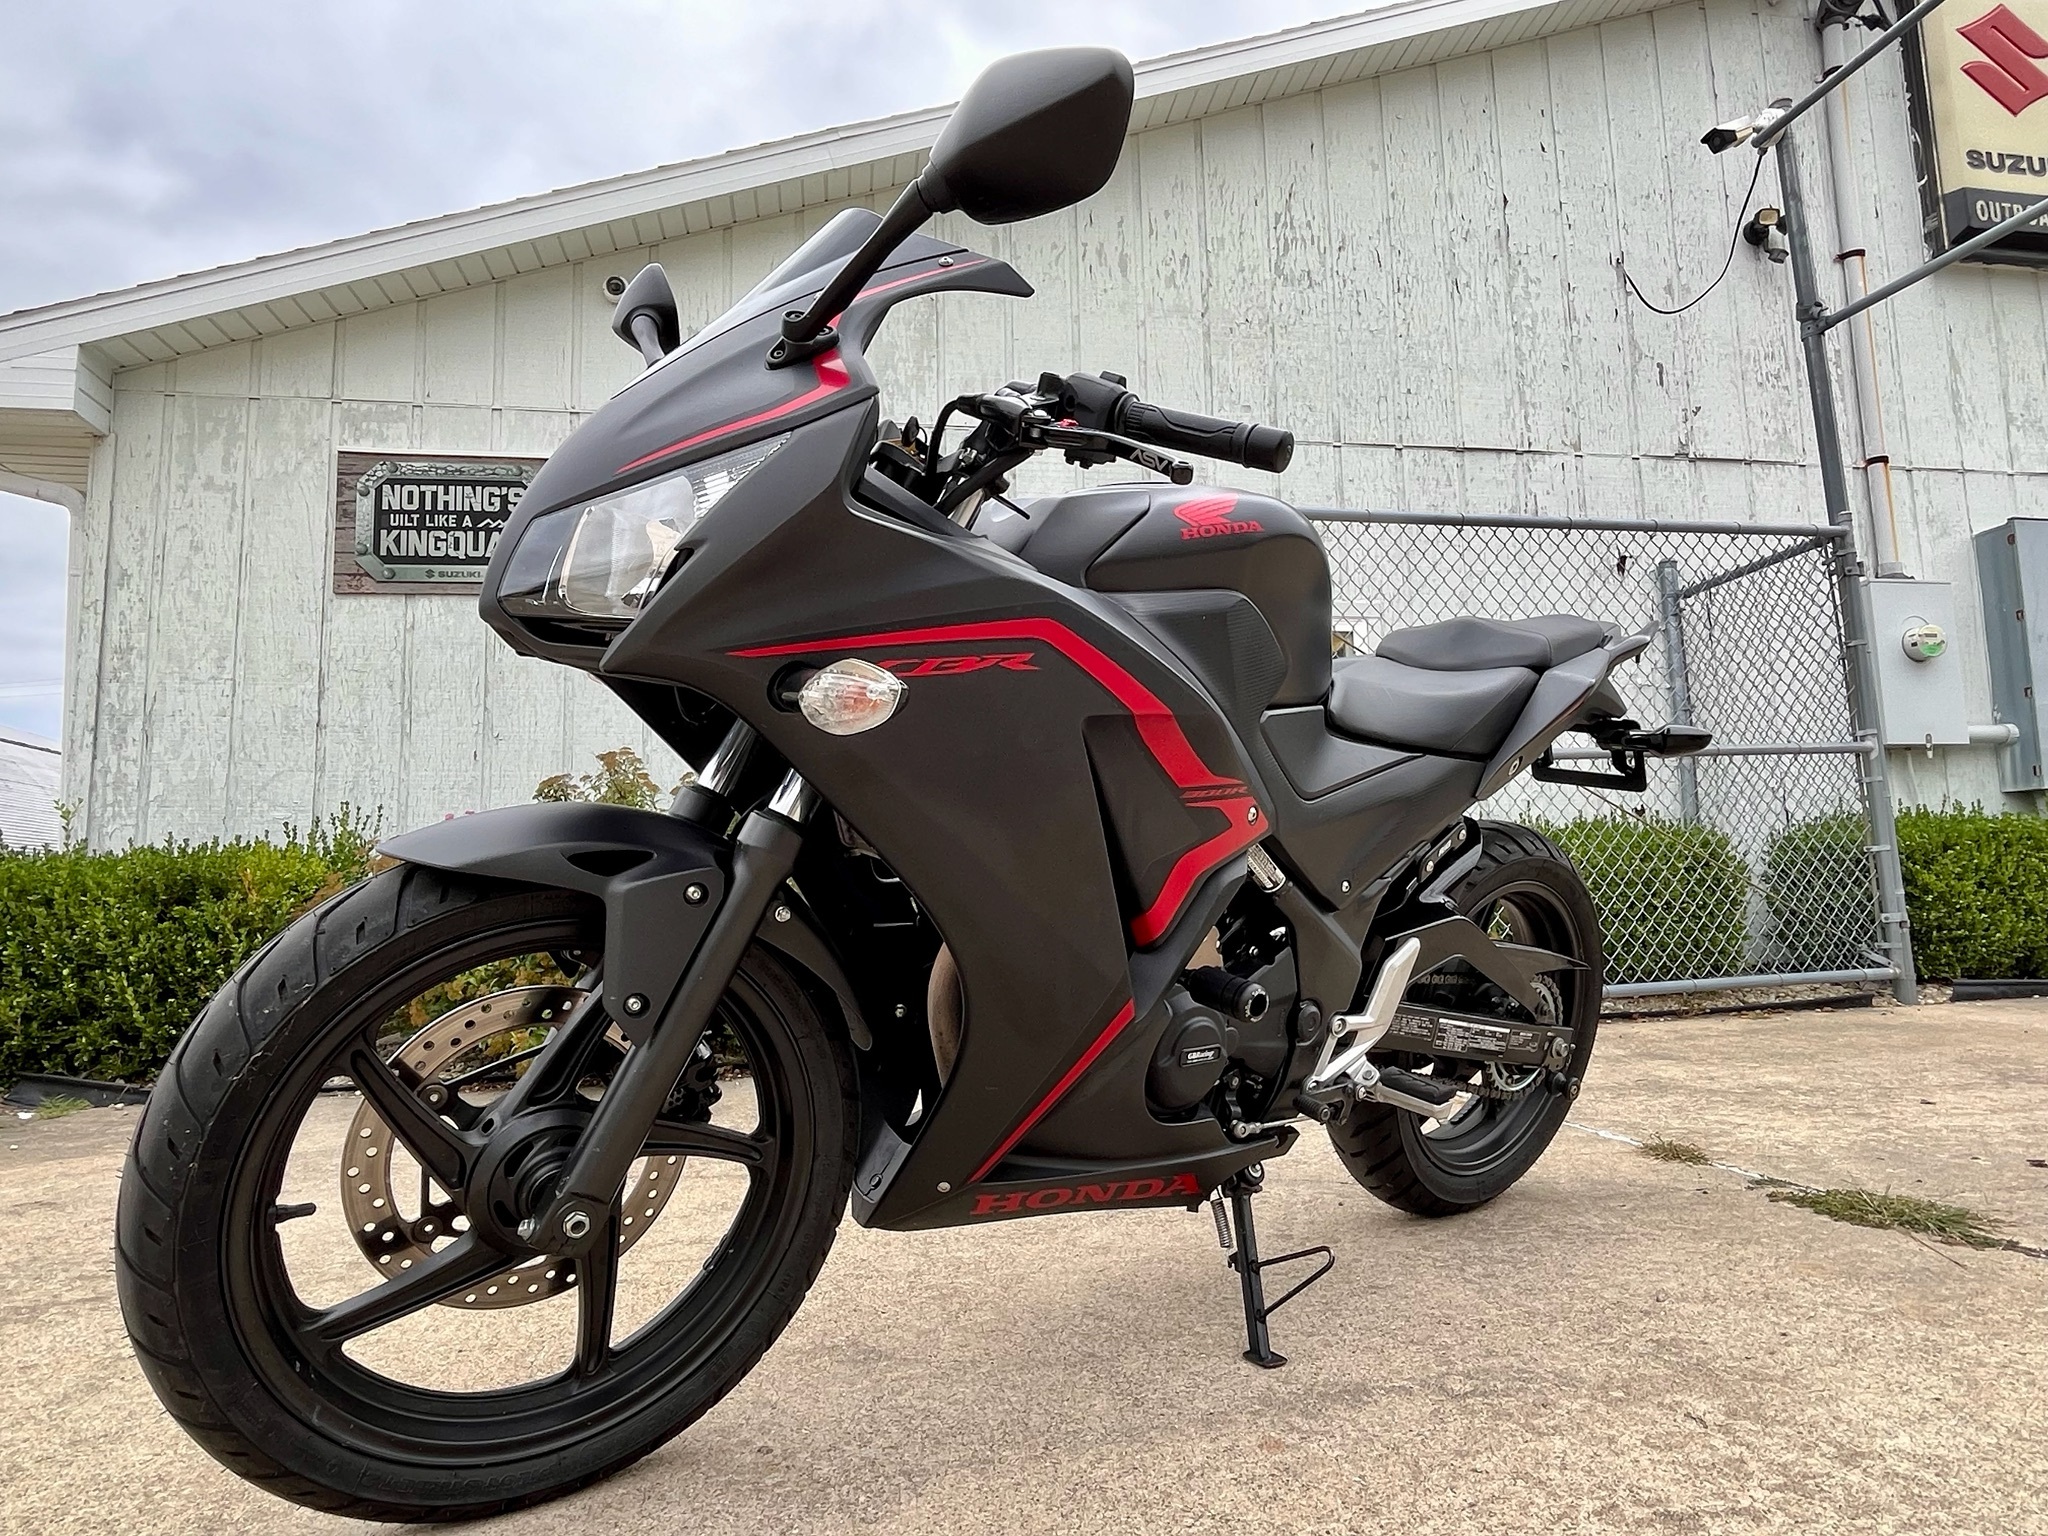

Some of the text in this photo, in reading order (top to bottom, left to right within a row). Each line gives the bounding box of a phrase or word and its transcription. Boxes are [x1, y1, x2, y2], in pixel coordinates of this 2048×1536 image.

[1966, 149, 2048, 177] SUZU
[1129, 448, 1169, 471] ASV
[381, 484, 525, 513] NOTHING'S
[425, 514, 457, 528] LIKE
[461, 514, 473, 528] A
[1180, 520, 1265, 540] HONDA
[438, 570, 481, 579] SUZUKI
[875, 652, 1041, 678] CBR
[969, 1173, 1200, 1216] HONDA
